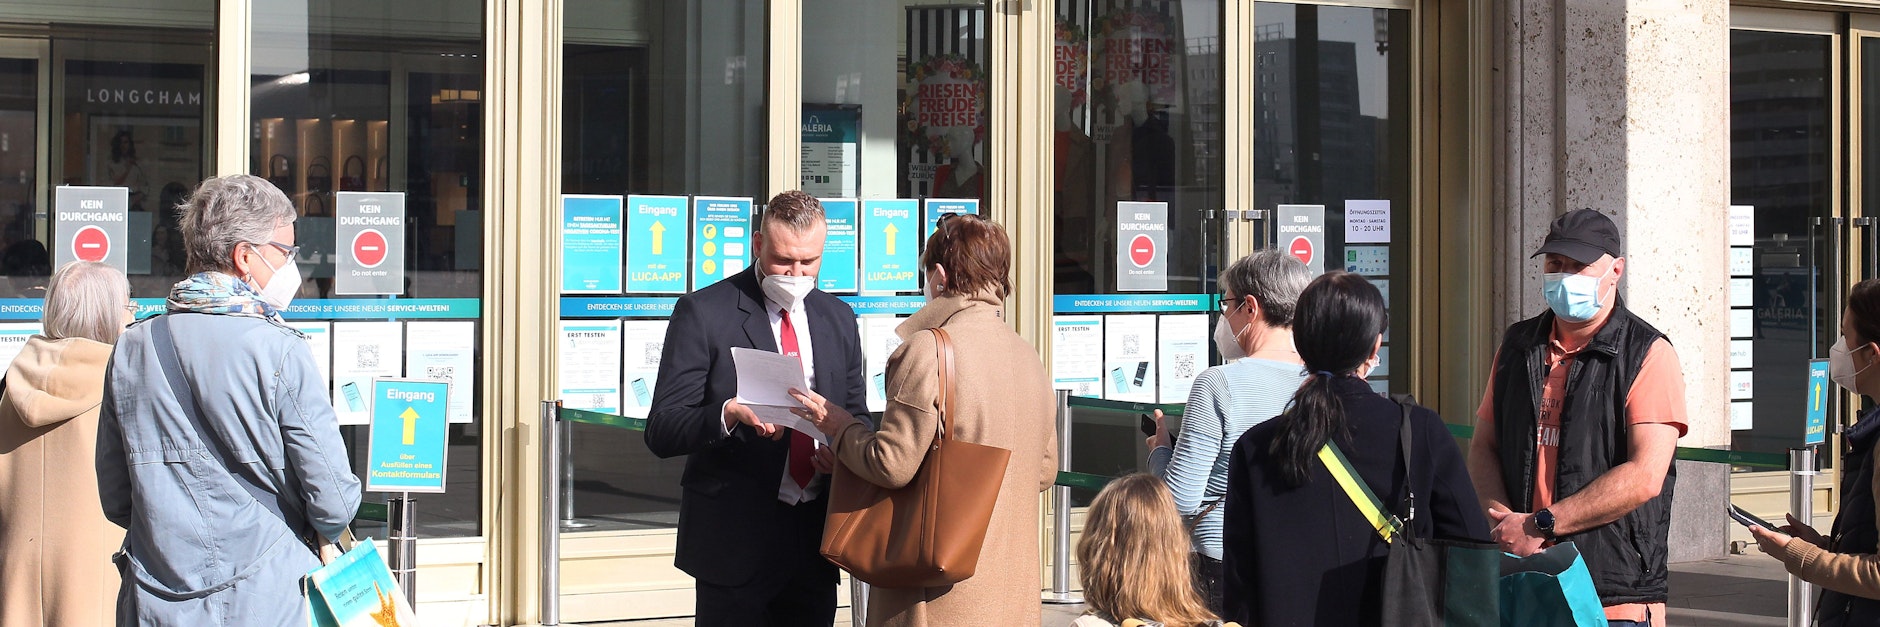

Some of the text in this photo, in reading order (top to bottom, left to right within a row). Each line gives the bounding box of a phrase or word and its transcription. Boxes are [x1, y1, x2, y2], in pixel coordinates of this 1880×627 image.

[918, 83, 976, 98] RIESEN
[87, 88, 201, 105] LONGCHAM
[918, 99, 976, 113] FREUDE
[918, 112, 976, 127] PREISE
[801, 123, 833, 133] ALERIA
[80, 200, 104, 210] KEIN
[359, 204, 381, 214] KEIN
[639, 204, 678, 217] Eingang
[873, 207, 908, 219] Eingang
[60, 212, 123, 222] DURCHGANG
[340, 216, 400, 226] DURCHGANG
[1134, 212, 1151, 221] KEIN
[1293, 215, 1309, 223] KEIN
[1120, 222, 1165, 231] DURCHGANG
[1280, 225, 1322, 233] DURCHGANG
[351, 269, 361, 277] Do
[363, 269, 372, 277] not
[631, 271, 682, 282] LUCA-APP
[868, 271, 914, 281] LUCA-APP
[1, 305, 43, 313] ENTDECKEN
[285, 304, 450, 313] NTDECKEN SIE UNSERE NEUEN SERVICE-WELTEN!
[587, 303, 676, 311] ENTDECKEN SIE UNSERE NEUE
[858, 301, 867, 309] SIE
[1757, 307, 1804, 320] GALERIA
[386, 388, 435, 403] Eingang
[380, 461, 413, 469] Ausfüllen
[371, 470, 440, 479] Kontaktformulars
